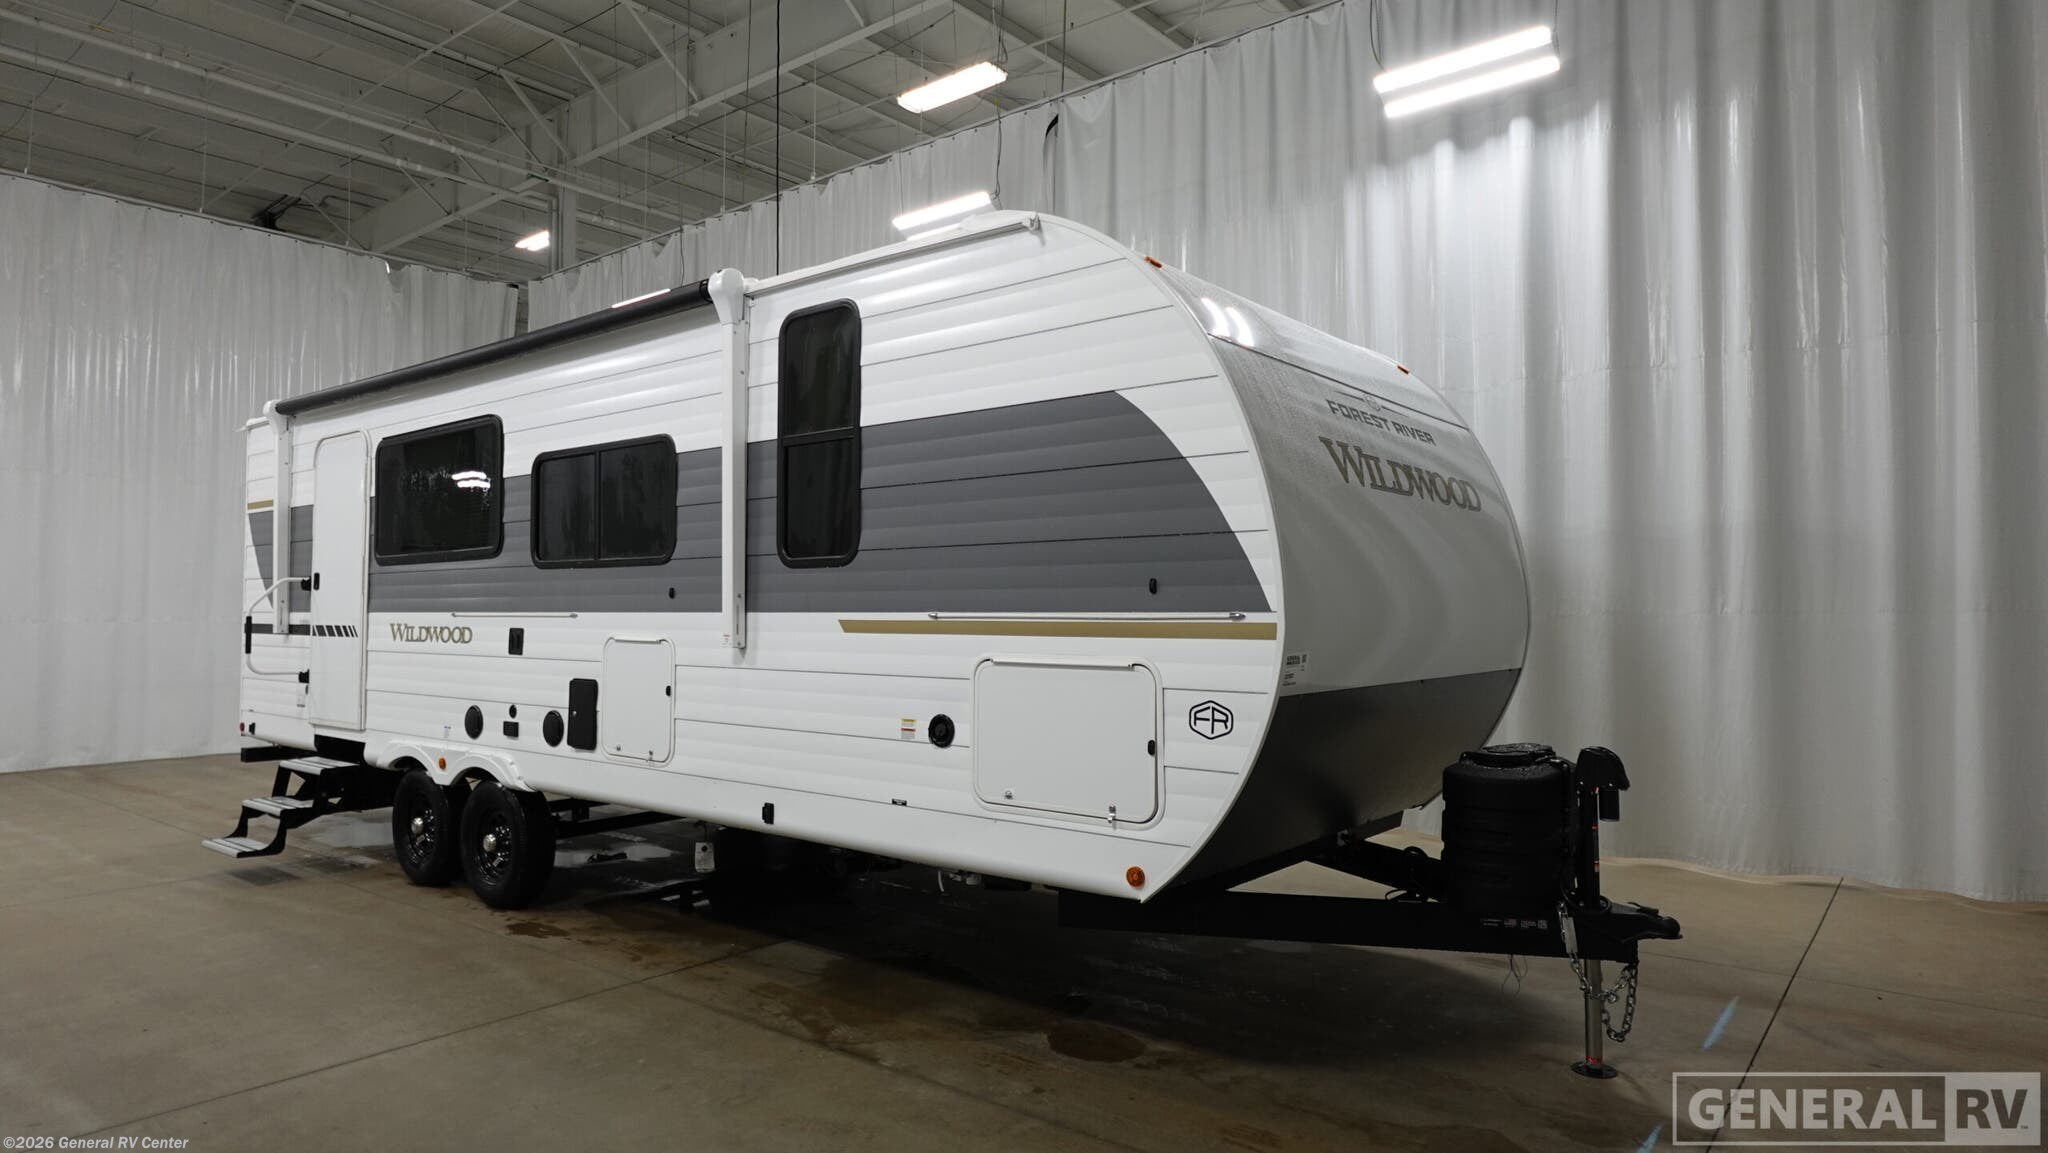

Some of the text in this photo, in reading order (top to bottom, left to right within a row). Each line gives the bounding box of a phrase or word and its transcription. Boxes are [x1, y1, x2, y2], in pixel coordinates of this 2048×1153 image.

[1325, 399, 1437, 446] FOREST RIVER
[1318, 435, 1482, 512] WILDWOOD
[390, 623, 473, 644] WILDWOOD
